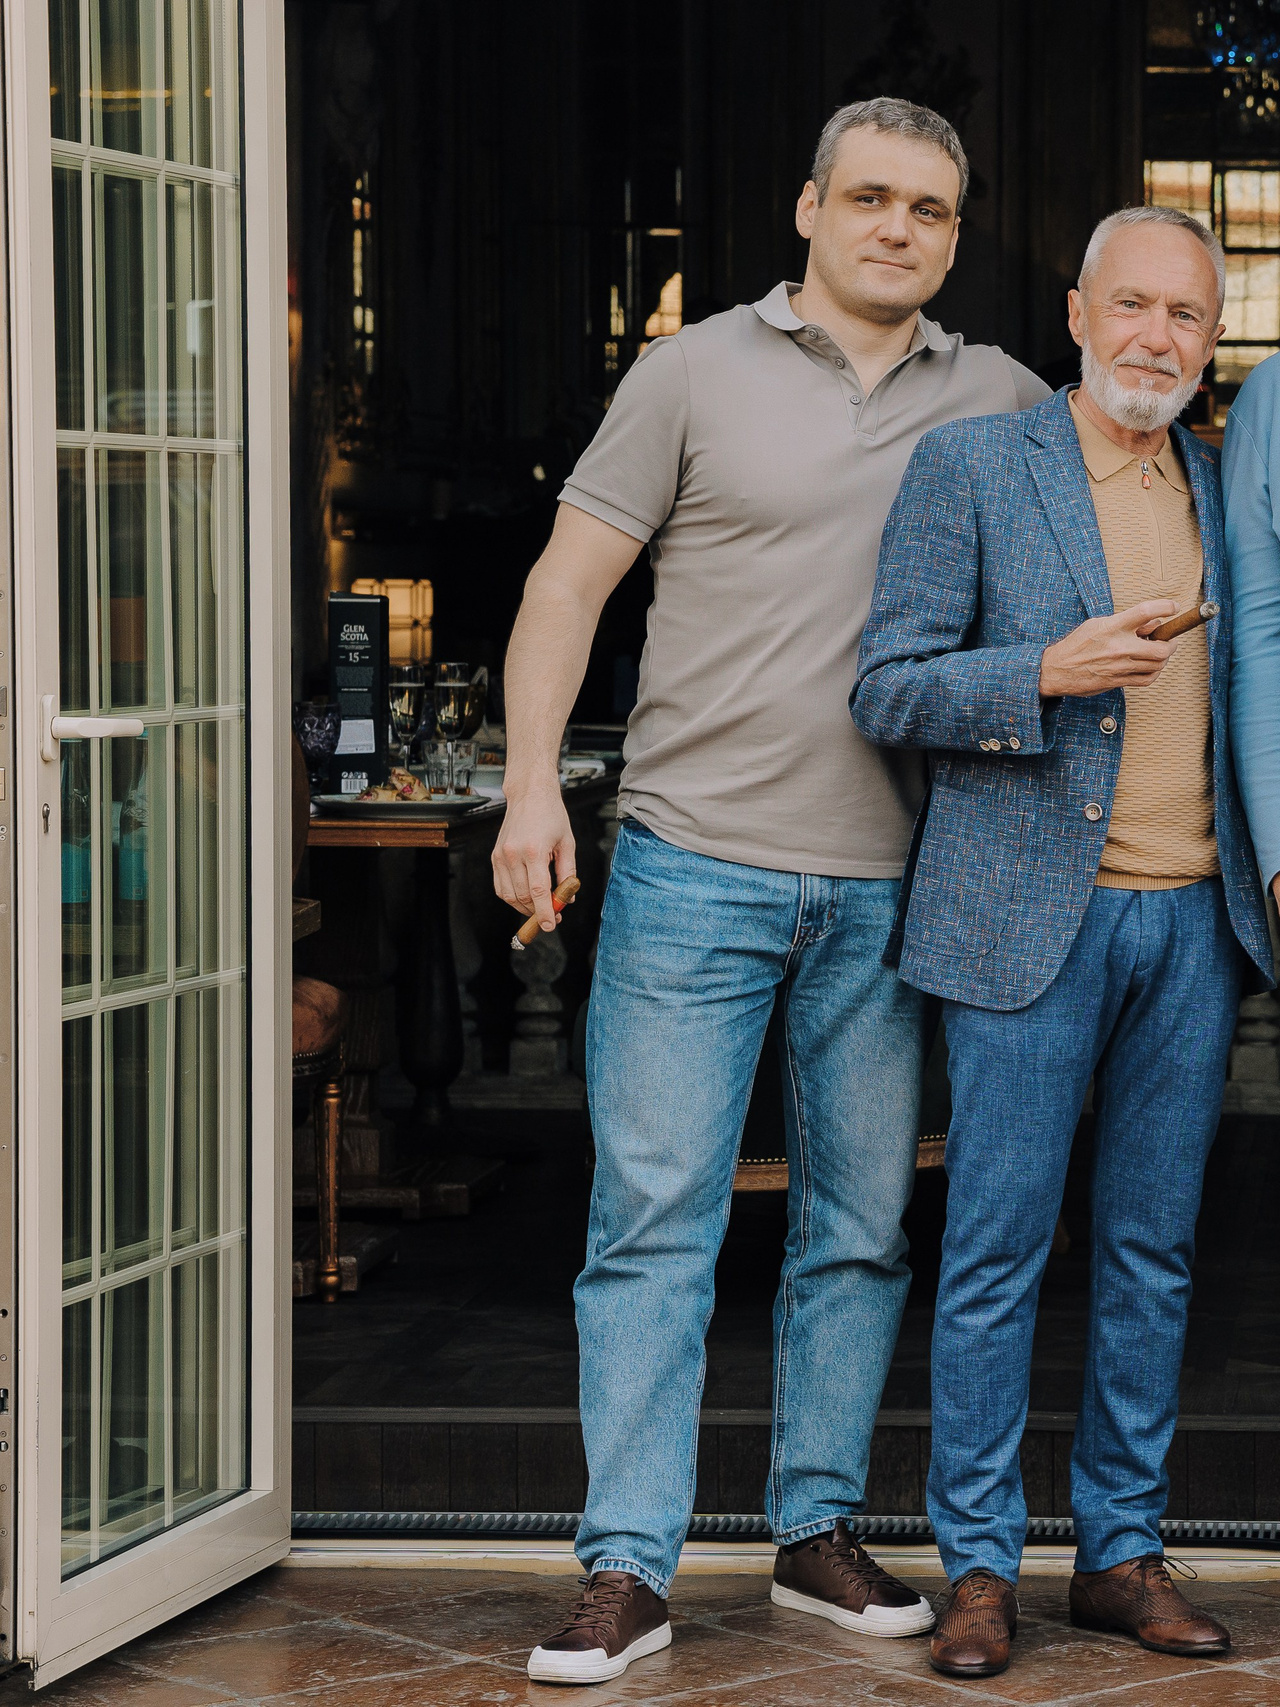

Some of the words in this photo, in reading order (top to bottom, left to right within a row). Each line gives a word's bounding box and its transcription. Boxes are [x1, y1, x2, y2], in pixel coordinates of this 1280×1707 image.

[343, 623, 365, 633] GLEN
[340, 632, 369, 641] SCOTIA
[348, 652, 360, 663] 15
